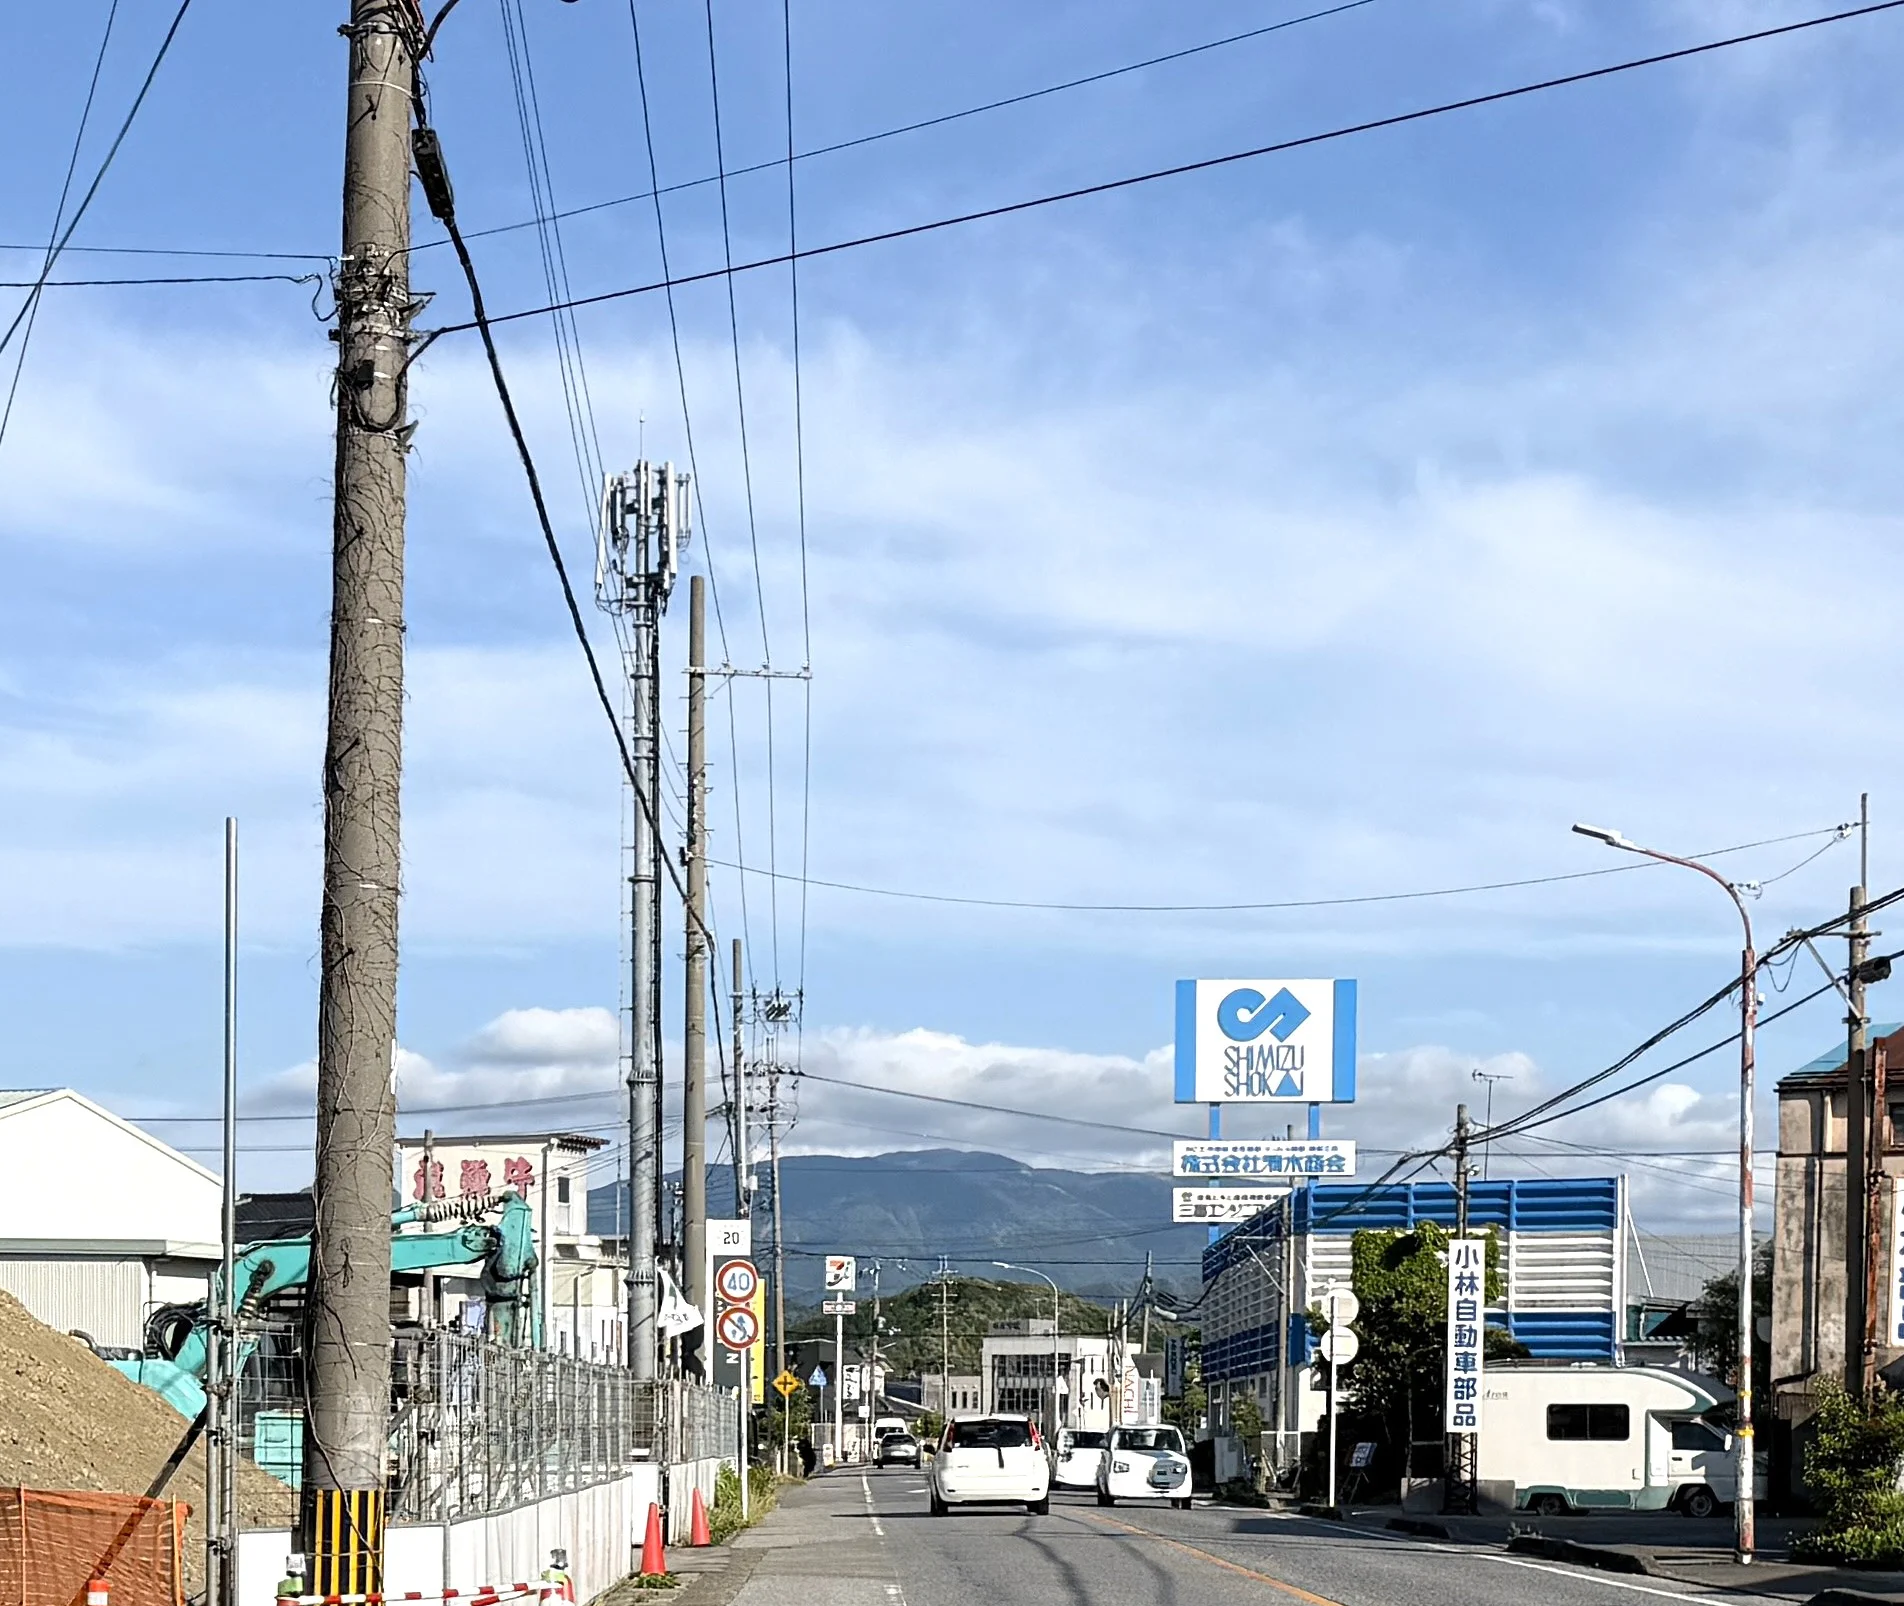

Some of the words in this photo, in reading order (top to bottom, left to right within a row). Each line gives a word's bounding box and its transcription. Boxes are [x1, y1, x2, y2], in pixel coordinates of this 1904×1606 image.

[1224, 1044, 1304, 1071] SHIMIZU
[1224, 1070, 1304, 1096] SHOKAI
[727, 1272, 751, 1291] 40
[1453, 1245, 1479, 1426] 小林自動車部品
